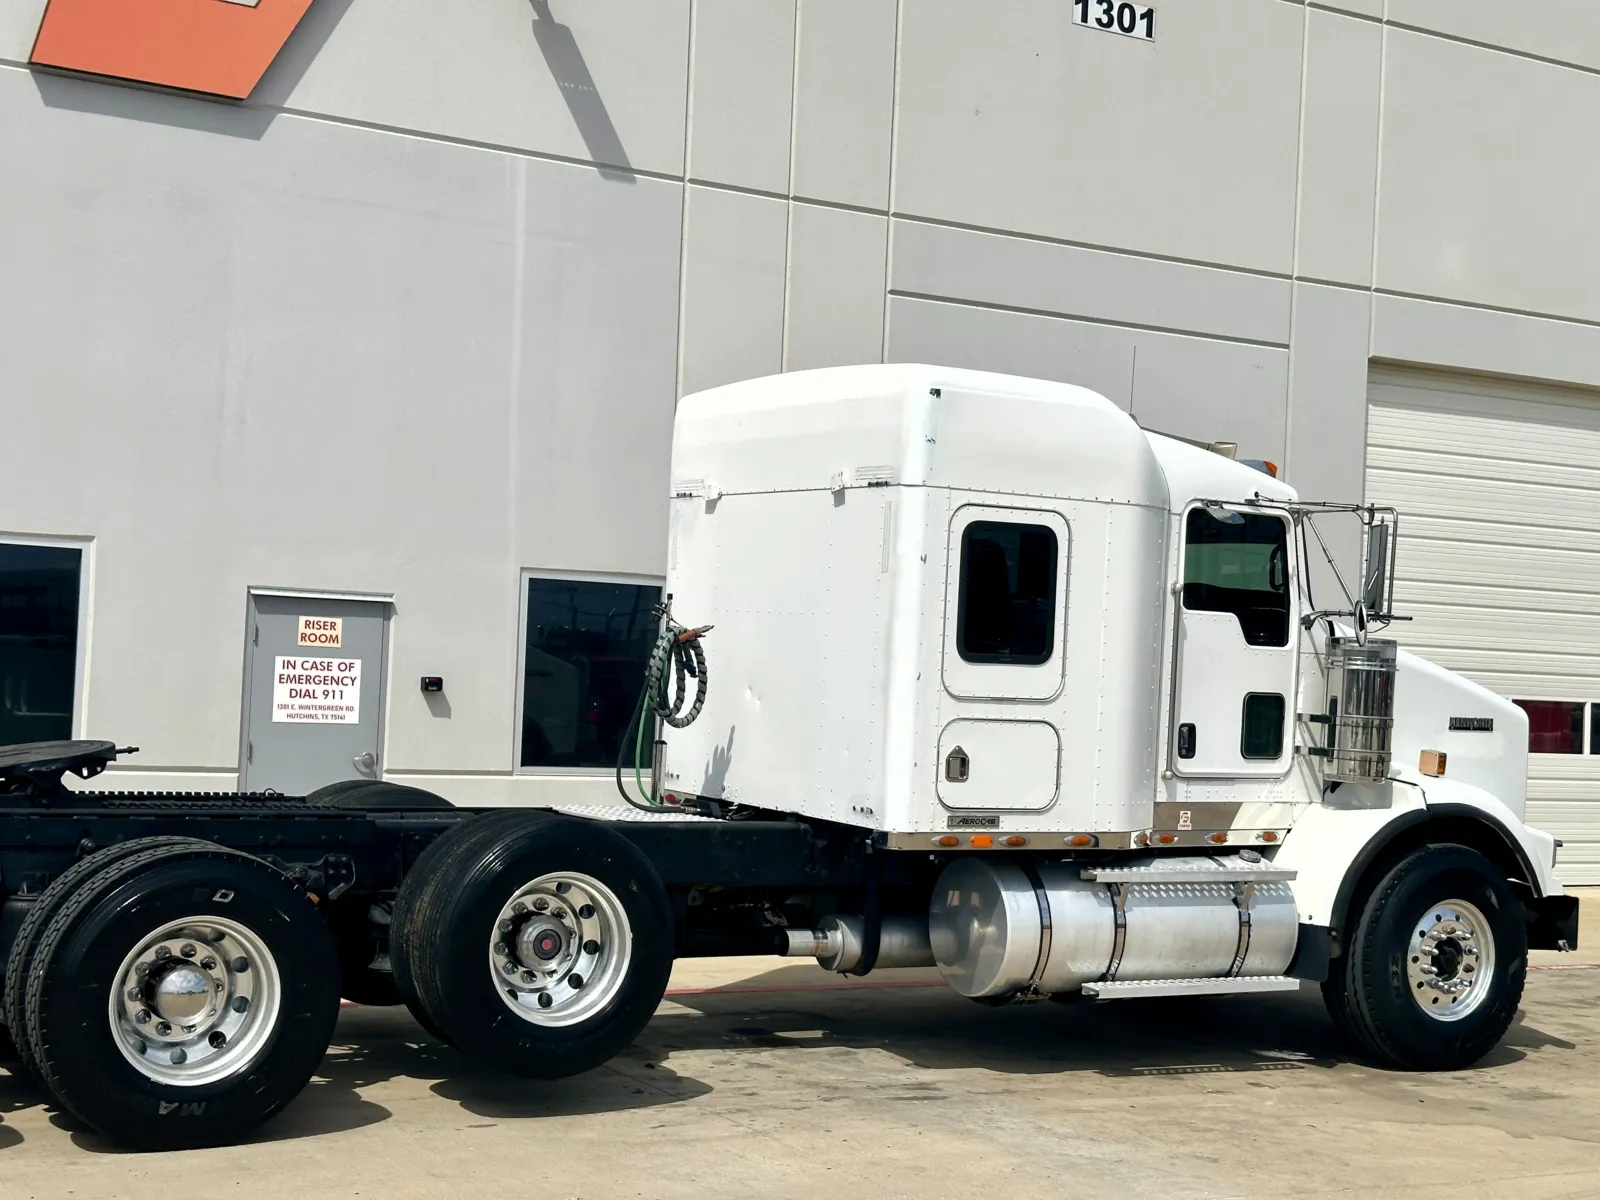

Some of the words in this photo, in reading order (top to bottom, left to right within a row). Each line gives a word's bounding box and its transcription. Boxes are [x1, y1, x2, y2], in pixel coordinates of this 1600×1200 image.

[1074, 0, 1154, 38] 1301
[304, 619, 337, 631] RISER
[300, 632, 339, 644] ROOM
[282, 659, 297, 670] IN
[301, 660, 333, 671] CASE
[337, 662, 355, 672] OF
[278, 673, 357, 687] EMERGENCY
[289, 688, 318, 699] DIAL
[322, 689, 344, 700] 911
[298, 704, 344, 712] WINTERGREEN
[286, 712, 320, 720] HUTCHINS,
